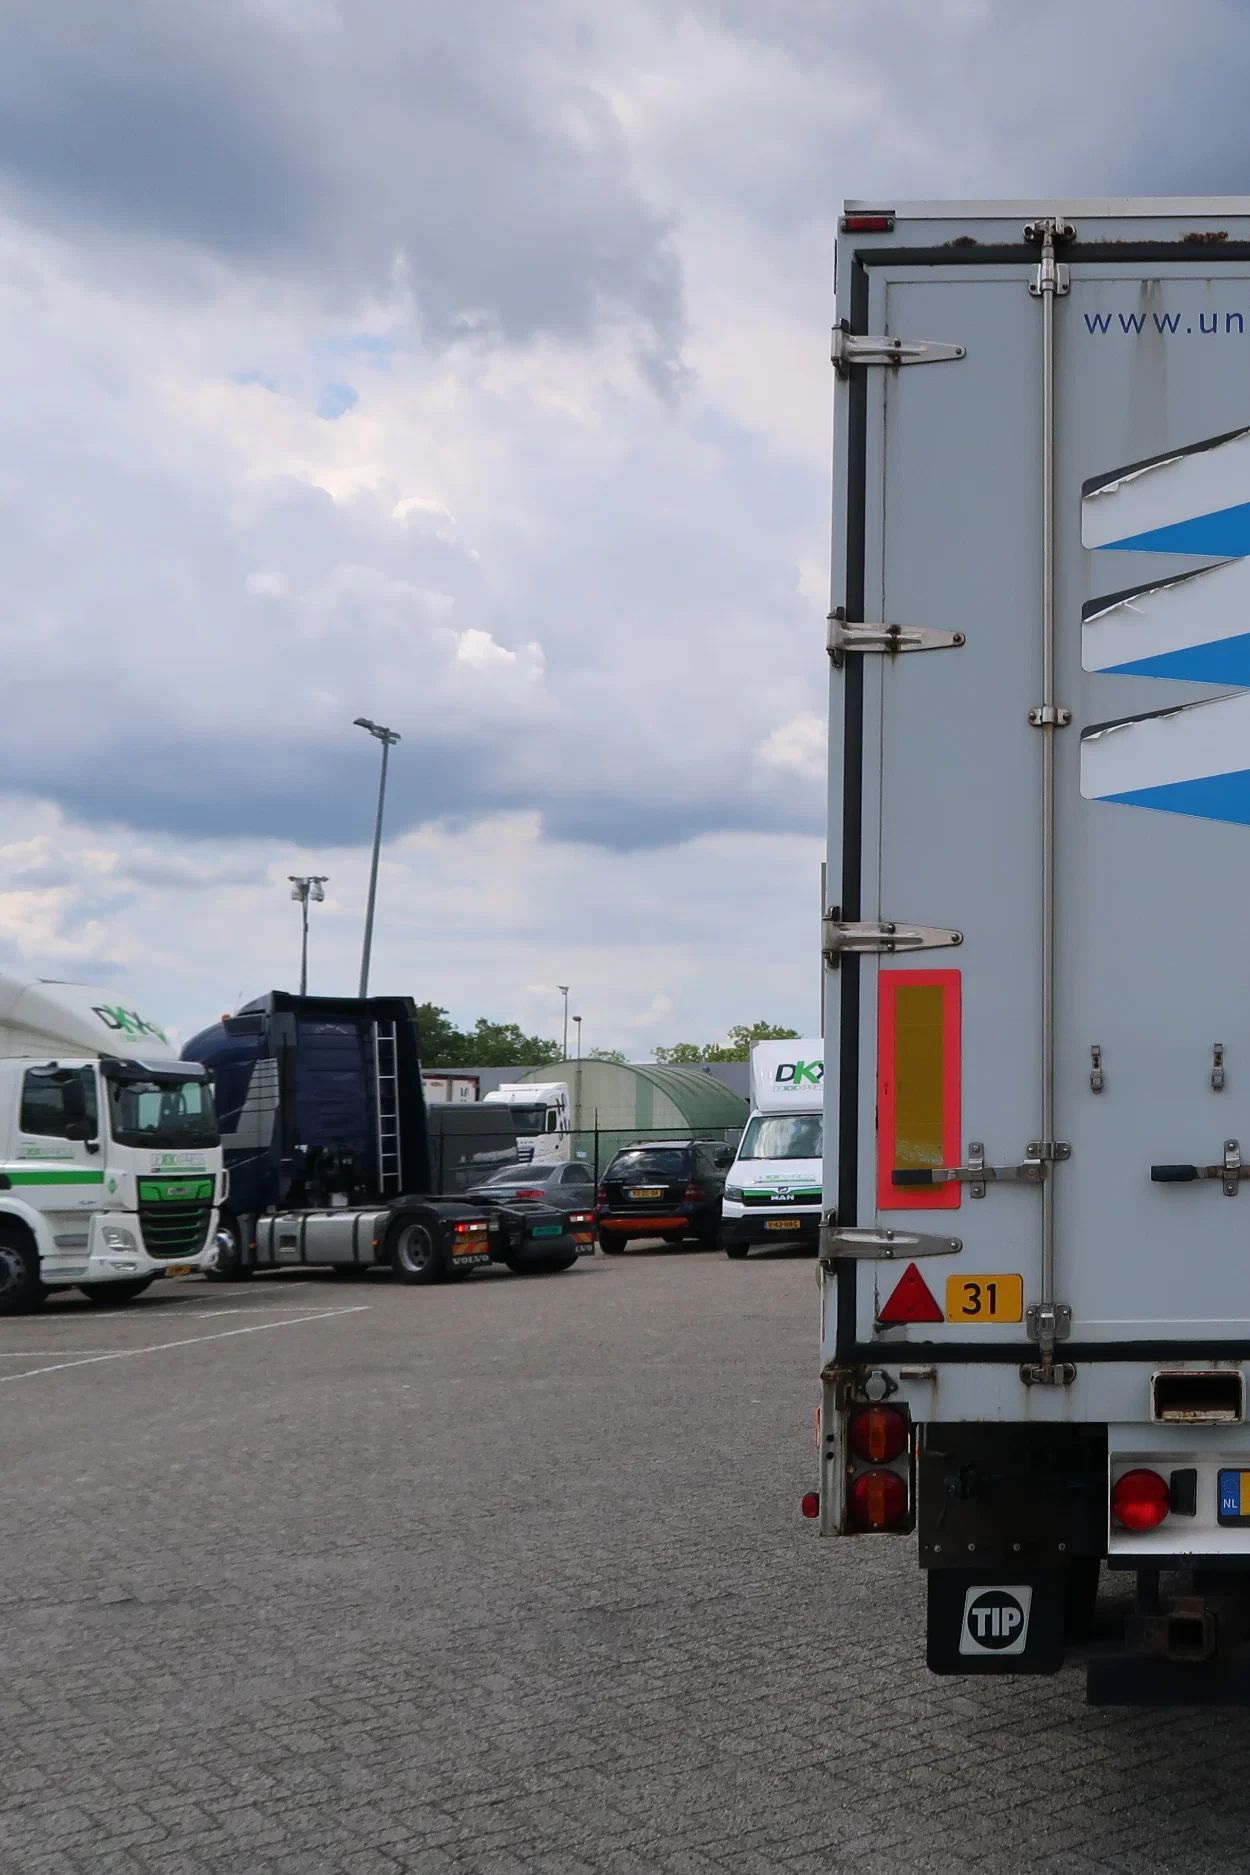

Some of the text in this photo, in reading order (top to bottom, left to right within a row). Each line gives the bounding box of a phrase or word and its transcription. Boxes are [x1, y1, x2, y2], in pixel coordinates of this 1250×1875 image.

[575, 1245, 593, 1253] LVO
[452, 1255, 489, 1265] VOLVO
[962, 1283, 996, 1315] 31
[1223, 1499, 1238, 1508] NL
[972, 1607, 1021, 1637] TIP
